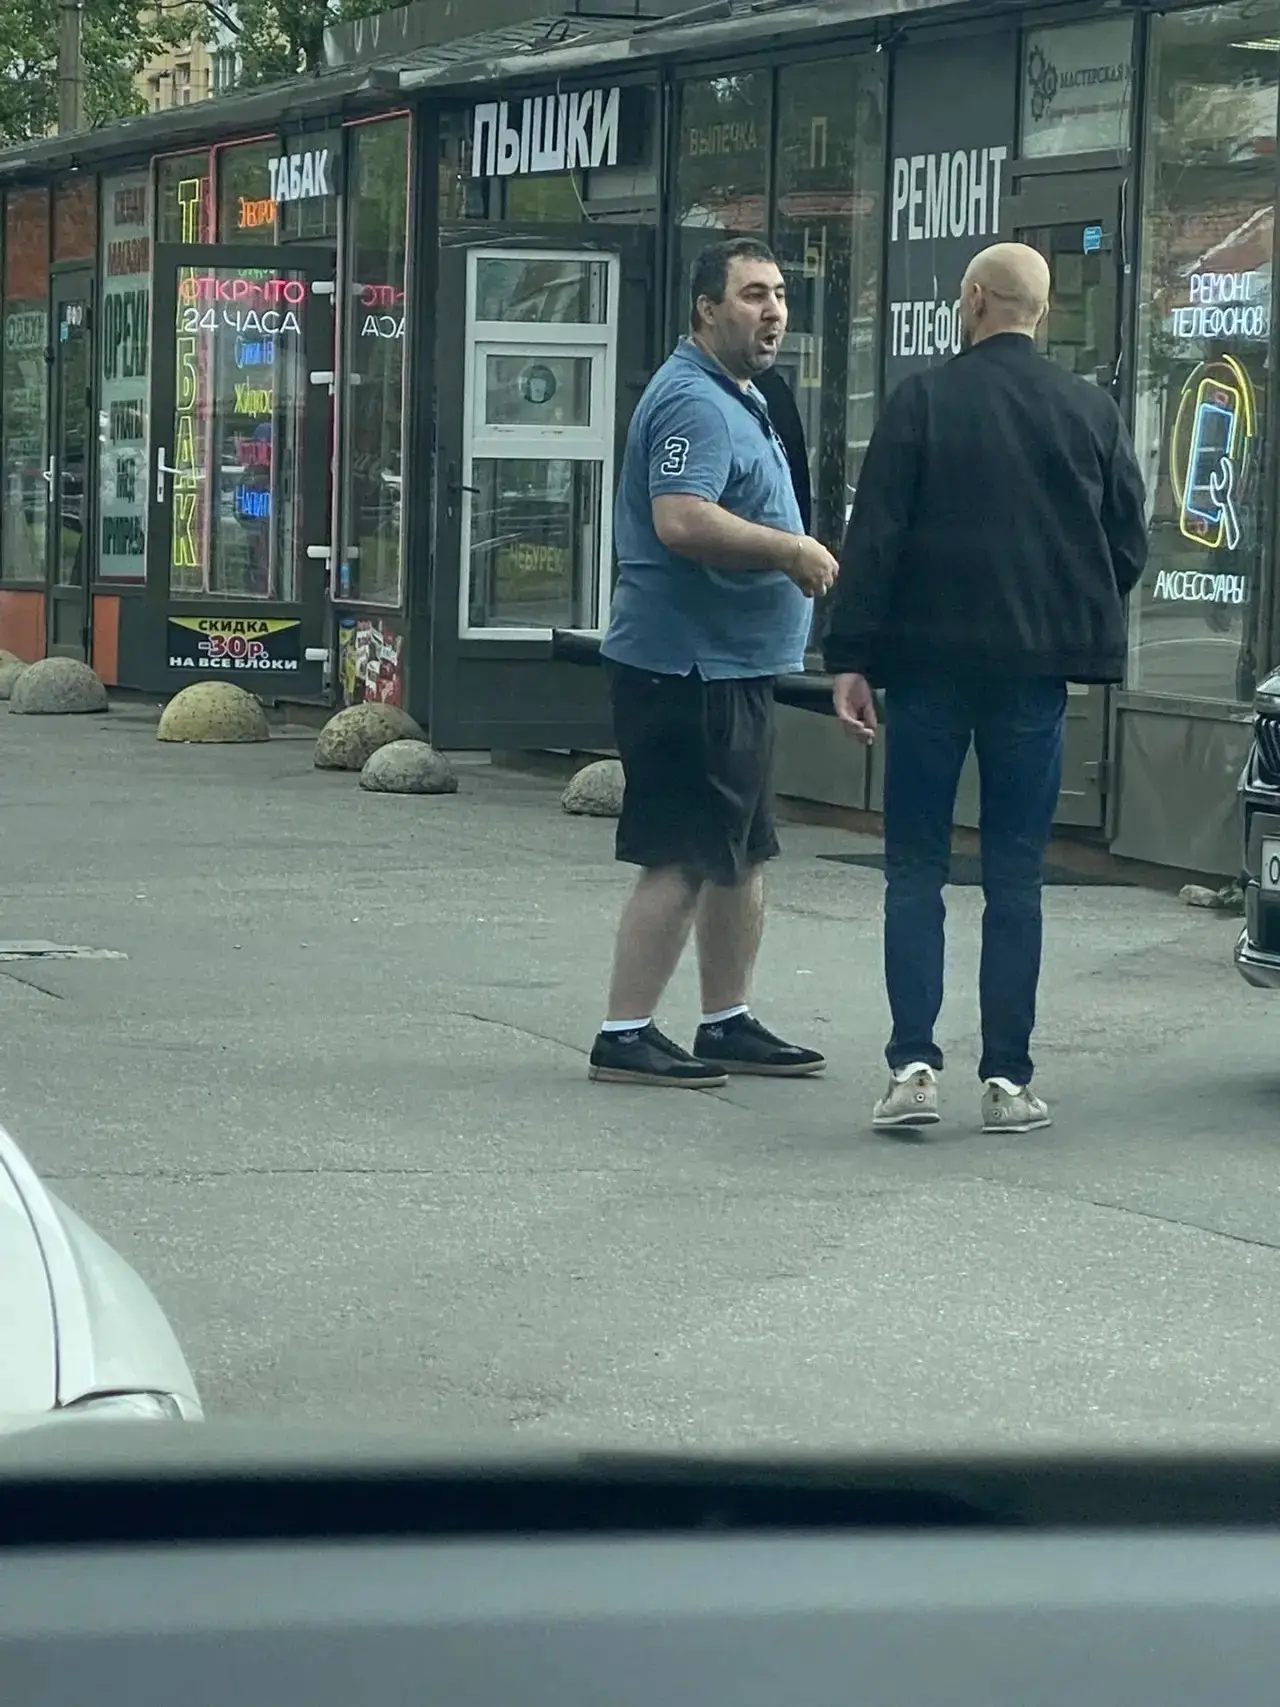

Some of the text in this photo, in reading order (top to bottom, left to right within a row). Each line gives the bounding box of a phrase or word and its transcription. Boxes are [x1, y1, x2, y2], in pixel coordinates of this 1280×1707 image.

[471, 87, 620, 177] ПЫШКИ
[689, 122, 758, 156] ВЫПЕЧКА
[268, 149, 328, 201] ТАБАК
[891, 146, 1007, 241] РЕМОНТ
[178, 278, 305, 303] ОТКРЫТО
[1189, 271, 1256, 304] РЕМОНТ
[184, 308, 302, 335] 24 ЧАСА
[891, 300, 962, 356] ТЕЛЕФО
[1171, 306, 1264, 338] ТЕЛЕФОНОВ
[661, 436, 689, 475] 3
[1154, 570, 1244, 603] АКСЕССУАРЫ
[198, 620, 269, 634] СКИДКА
[170, 657, 297, 670] НА ВСЕ БЛОКИ
